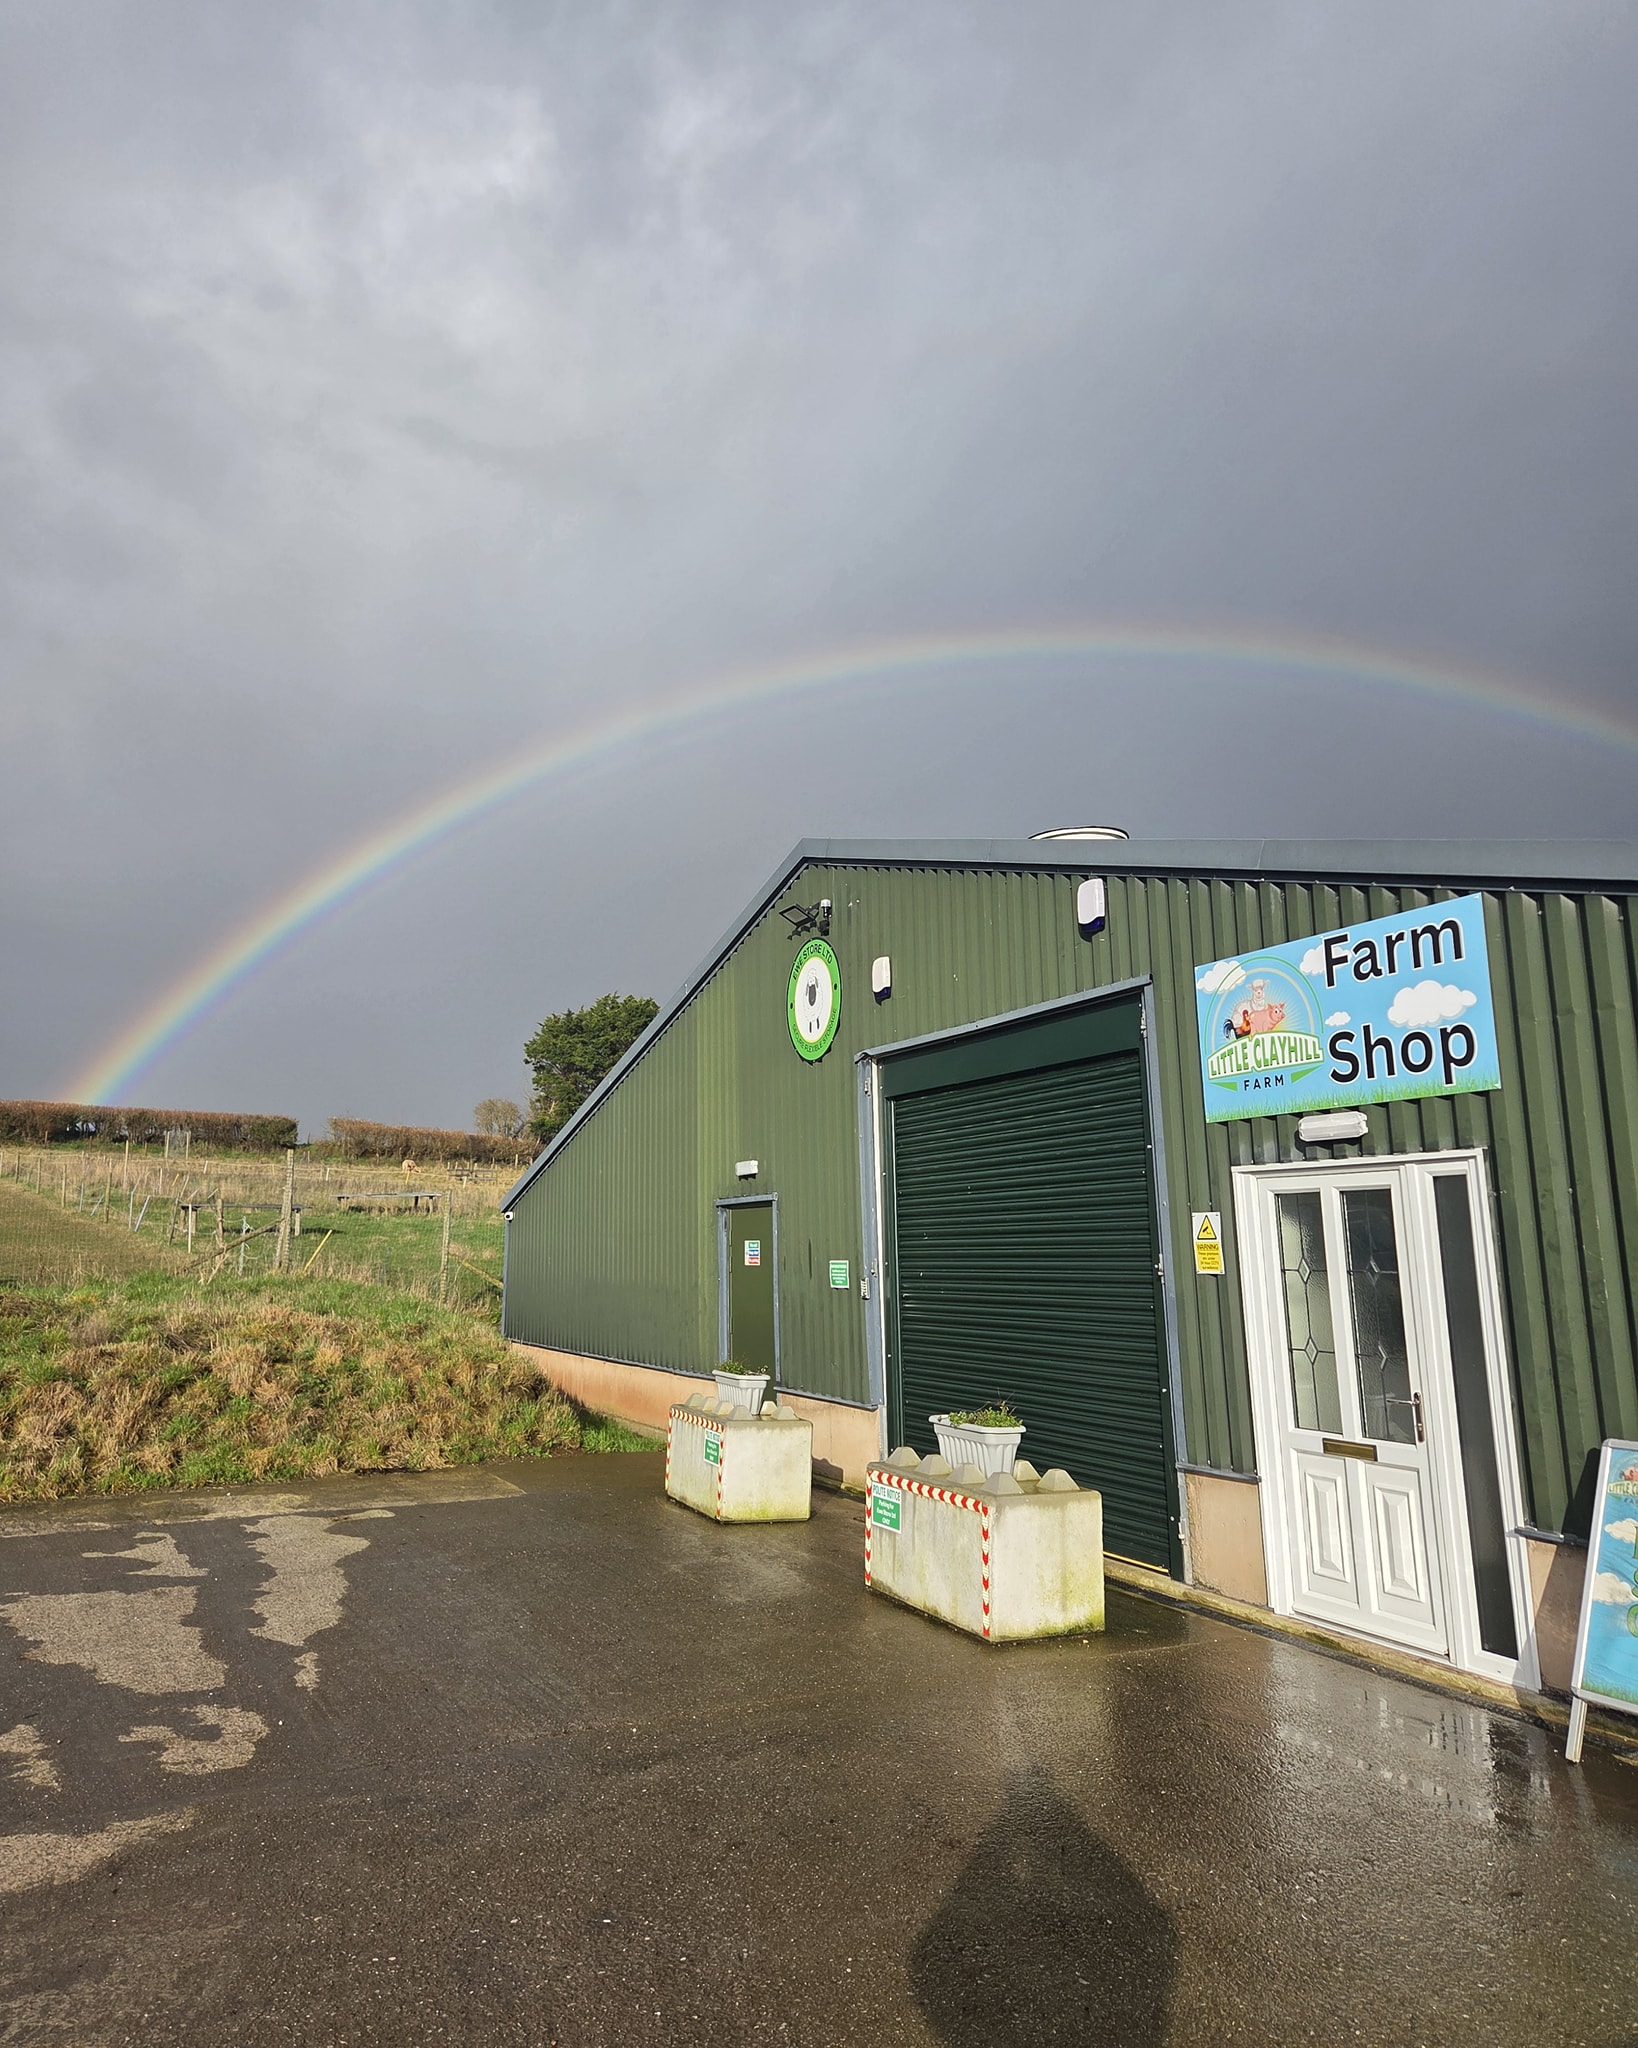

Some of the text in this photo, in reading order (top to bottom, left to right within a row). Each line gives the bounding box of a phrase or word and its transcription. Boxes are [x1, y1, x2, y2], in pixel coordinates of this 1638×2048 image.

[792, 943, 833, 980] EWE STORE LTD
[1323, 919, 1463, 988] Farm
[1209, 1036, 1321, 1076] LITTLE CLAYHILL
[1330, 1023, 1475, 1085] Shop
[1244, 1075, 1284, 1091] FARM
[873, 1484, 901, 1502] POLITE NOTICE
[1609, 1482, 1630, 1494] LITTLE
